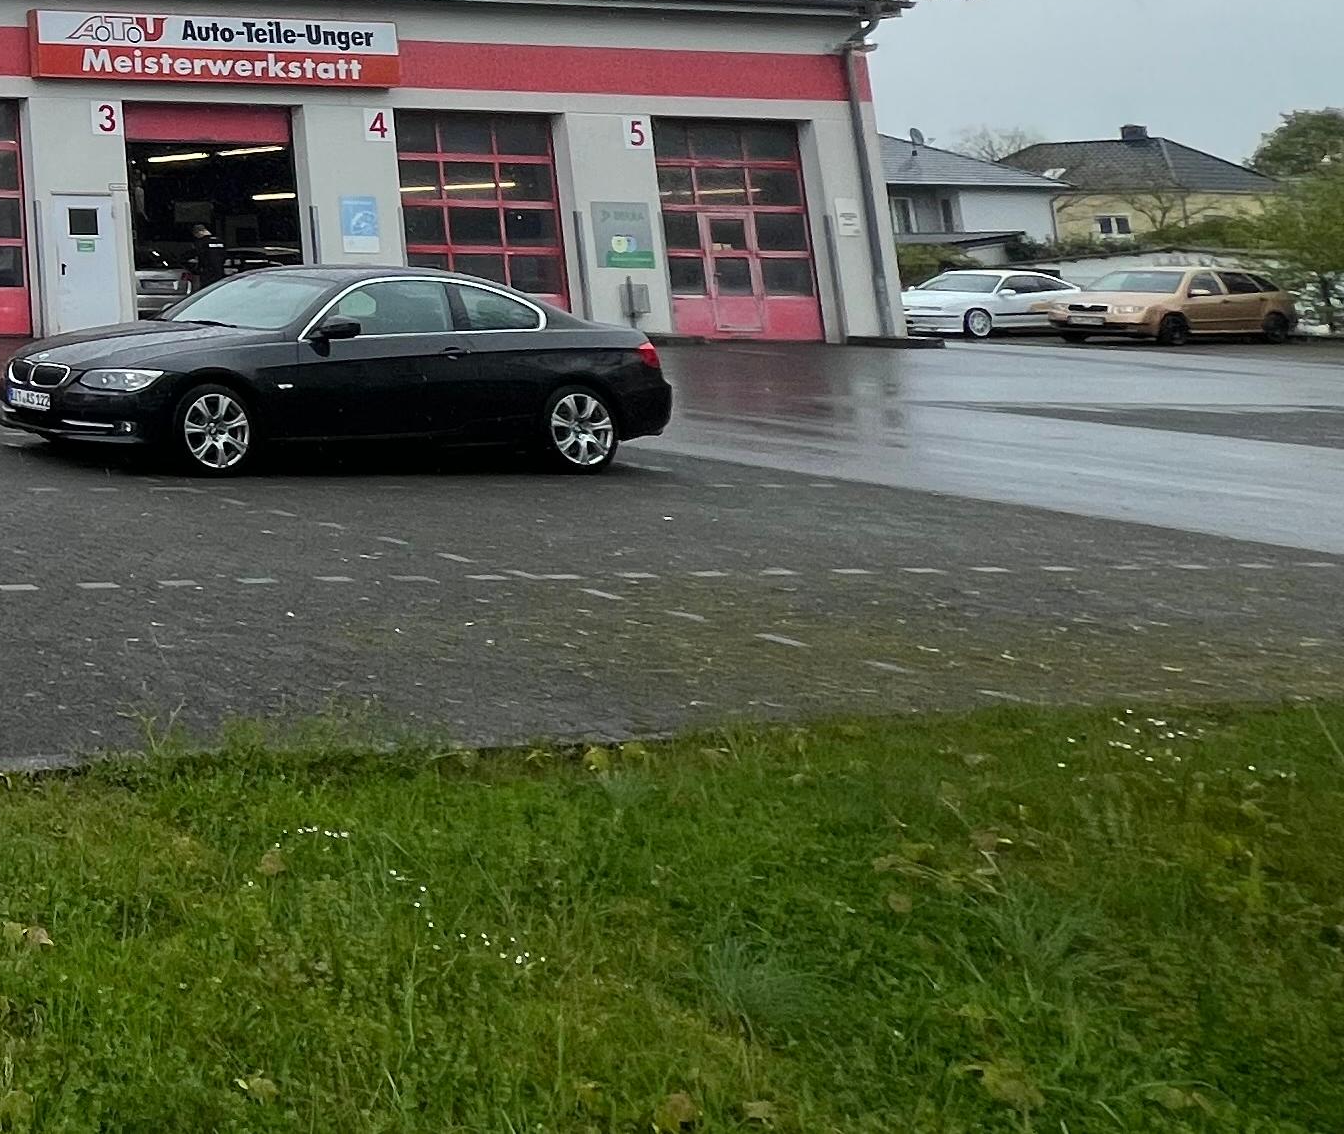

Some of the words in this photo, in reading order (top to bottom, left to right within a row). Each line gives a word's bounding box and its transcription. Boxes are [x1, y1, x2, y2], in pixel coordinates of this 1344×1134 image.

[181, 20, 374, 51] Auto-Teile-Unger
[82, 48, 362, 80] Meisterwerkstatt
[98, 104, 116, 132] 3
[369, 112, 388, 138] 4
[630, 120, 645, 146] 5
